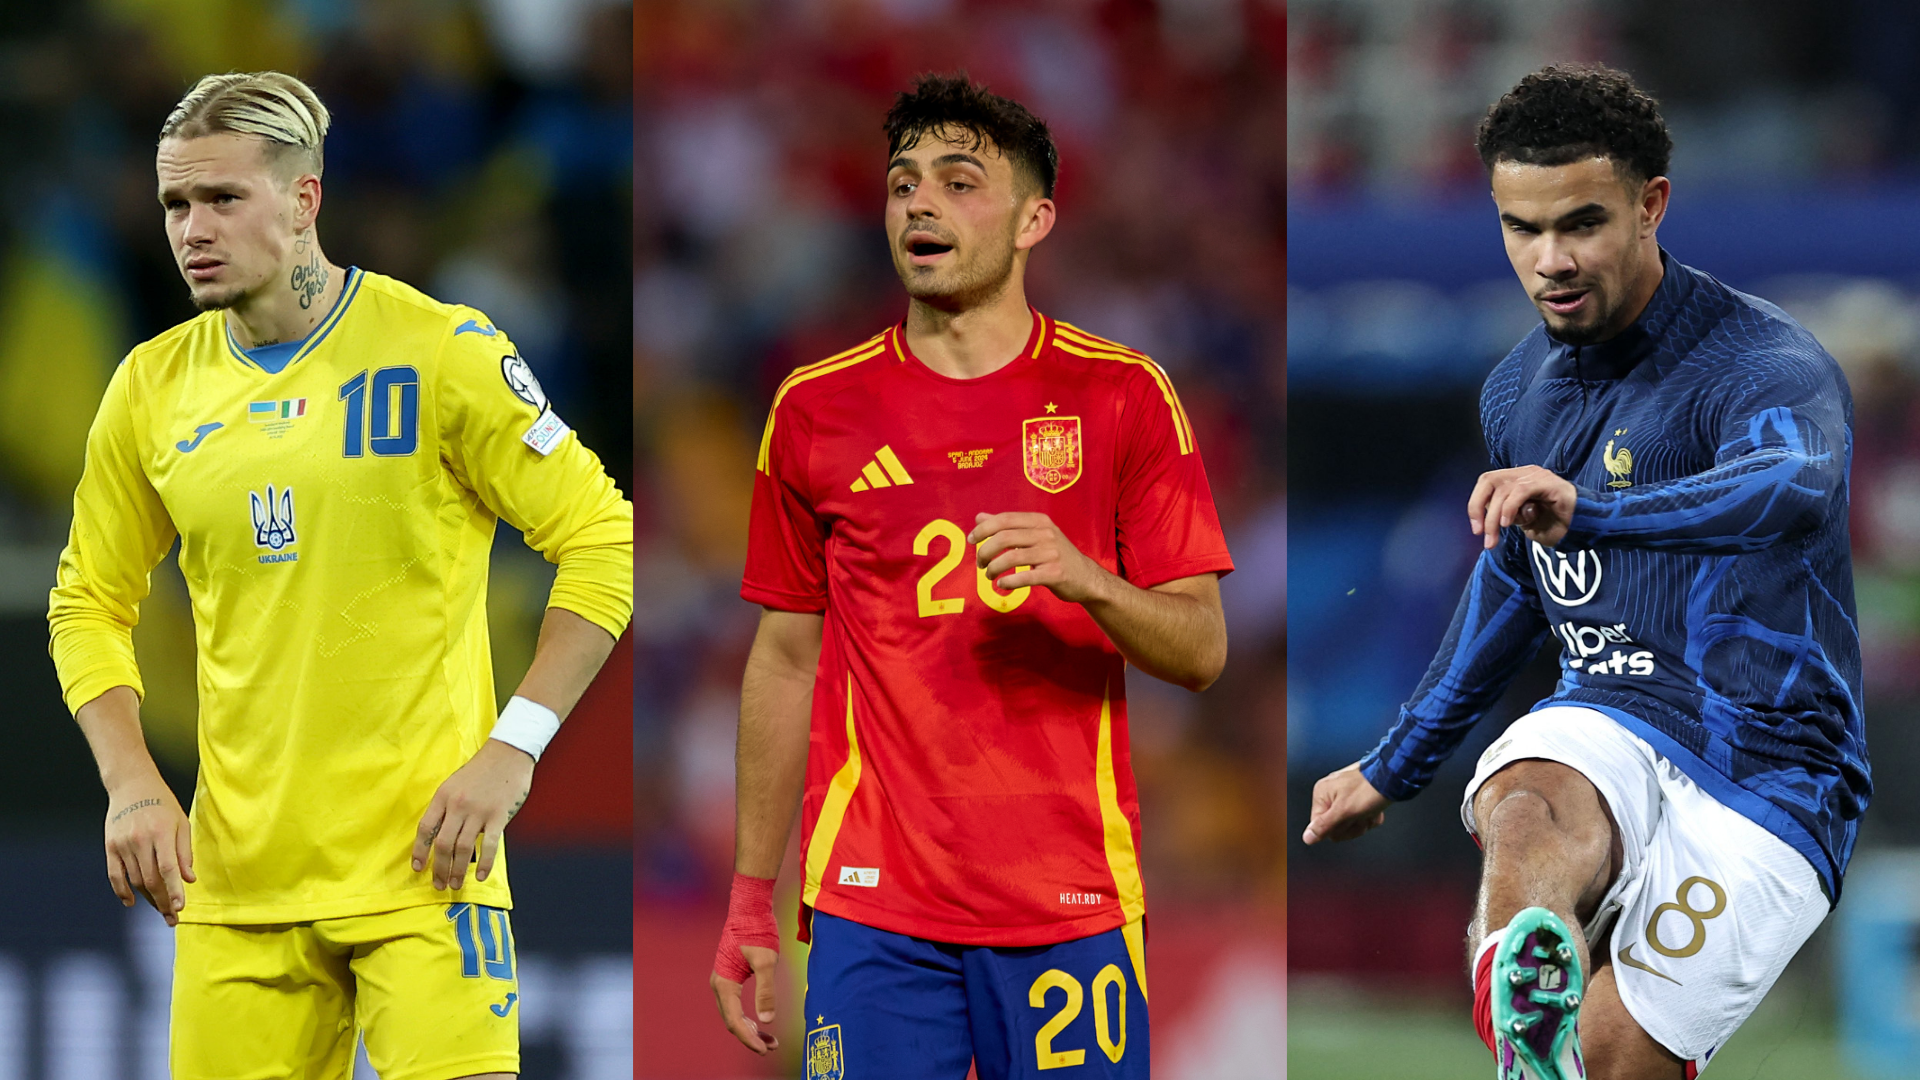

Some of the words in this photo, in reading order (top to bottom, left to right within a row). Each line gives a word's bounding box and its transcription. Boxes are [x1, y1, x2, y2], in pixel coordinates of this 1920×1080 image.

[338, 364, 419, 458] 10
[258, 552, 298, 564] UKRAINE
[1568, 650, 1655, 676] ats
[1059, 893, 1102, 904] HEAT.RDY
[1646, 876, 1727, 958] 8
[445, 903, 513, 982] 10
[1028, 964, 1127, 1070] 20
